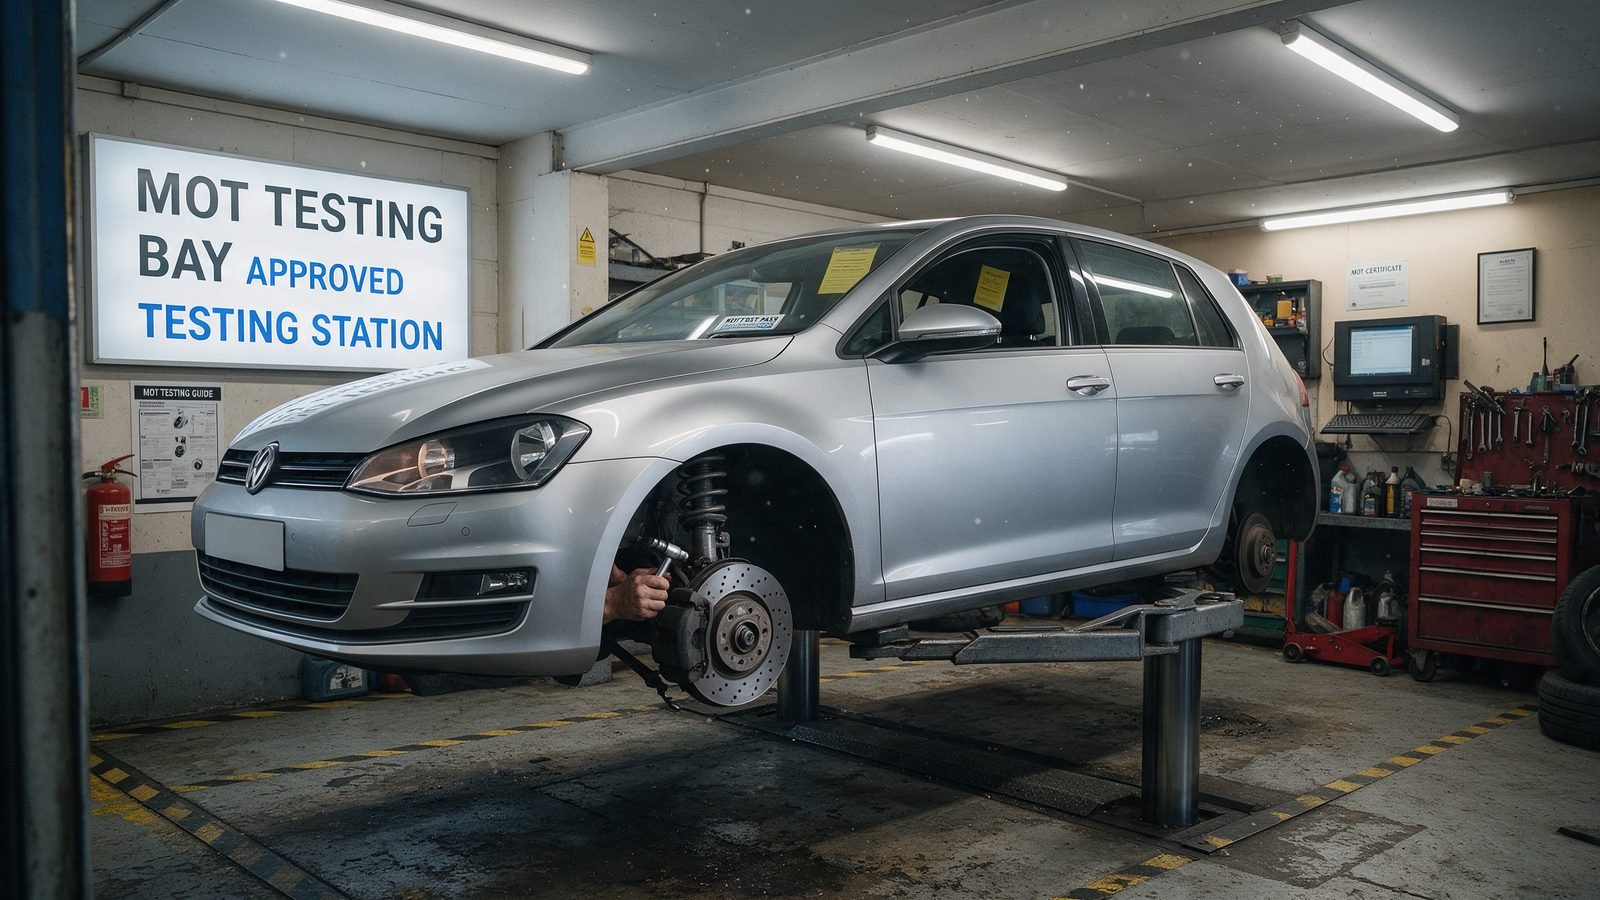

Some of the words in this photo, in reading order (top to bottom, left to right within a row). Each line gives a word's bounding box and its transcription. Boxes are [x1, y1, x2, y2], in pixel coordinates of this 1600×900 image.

[137, 168, 248, 222] MOT
[265, 185, 443, 243] TESTING
[138, 234, 233, 282] BAY
[246, 256, 404, 295] APPROVED
[138, 302, 299, 345] TESTING
[311, 313, 443, 351] STATION
[143, 388, 160, 397] MOT
[160, 388, 190, 397] TESTING
[192, 389, 214, 398] GUIDE
